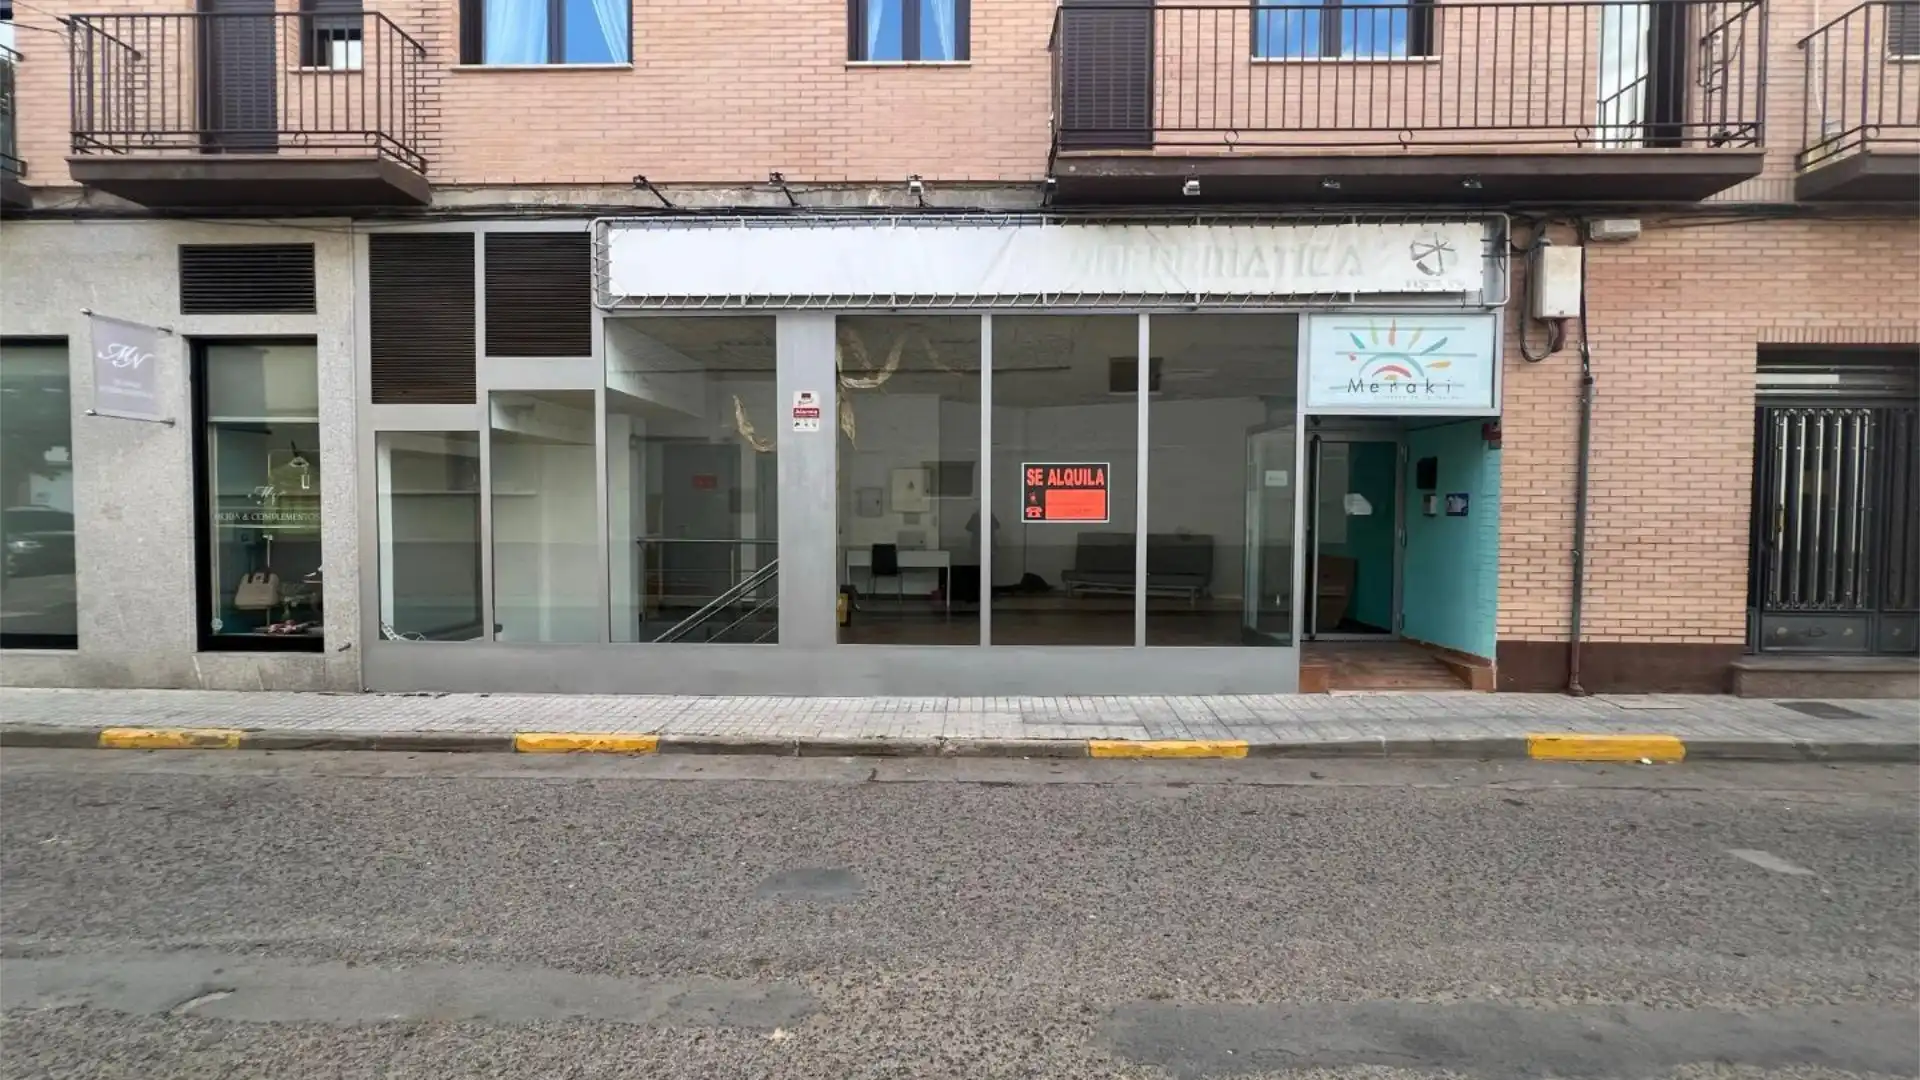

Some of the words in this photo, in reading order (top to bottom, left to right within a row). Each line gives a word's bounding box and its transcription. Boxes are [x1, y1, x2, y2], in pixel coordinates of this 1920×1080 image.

[1347, 377, 1452, 395] Meraki
[1026, 467, 1044, 486] SE
[1047, 467, 1105, 487] ALQUILA
